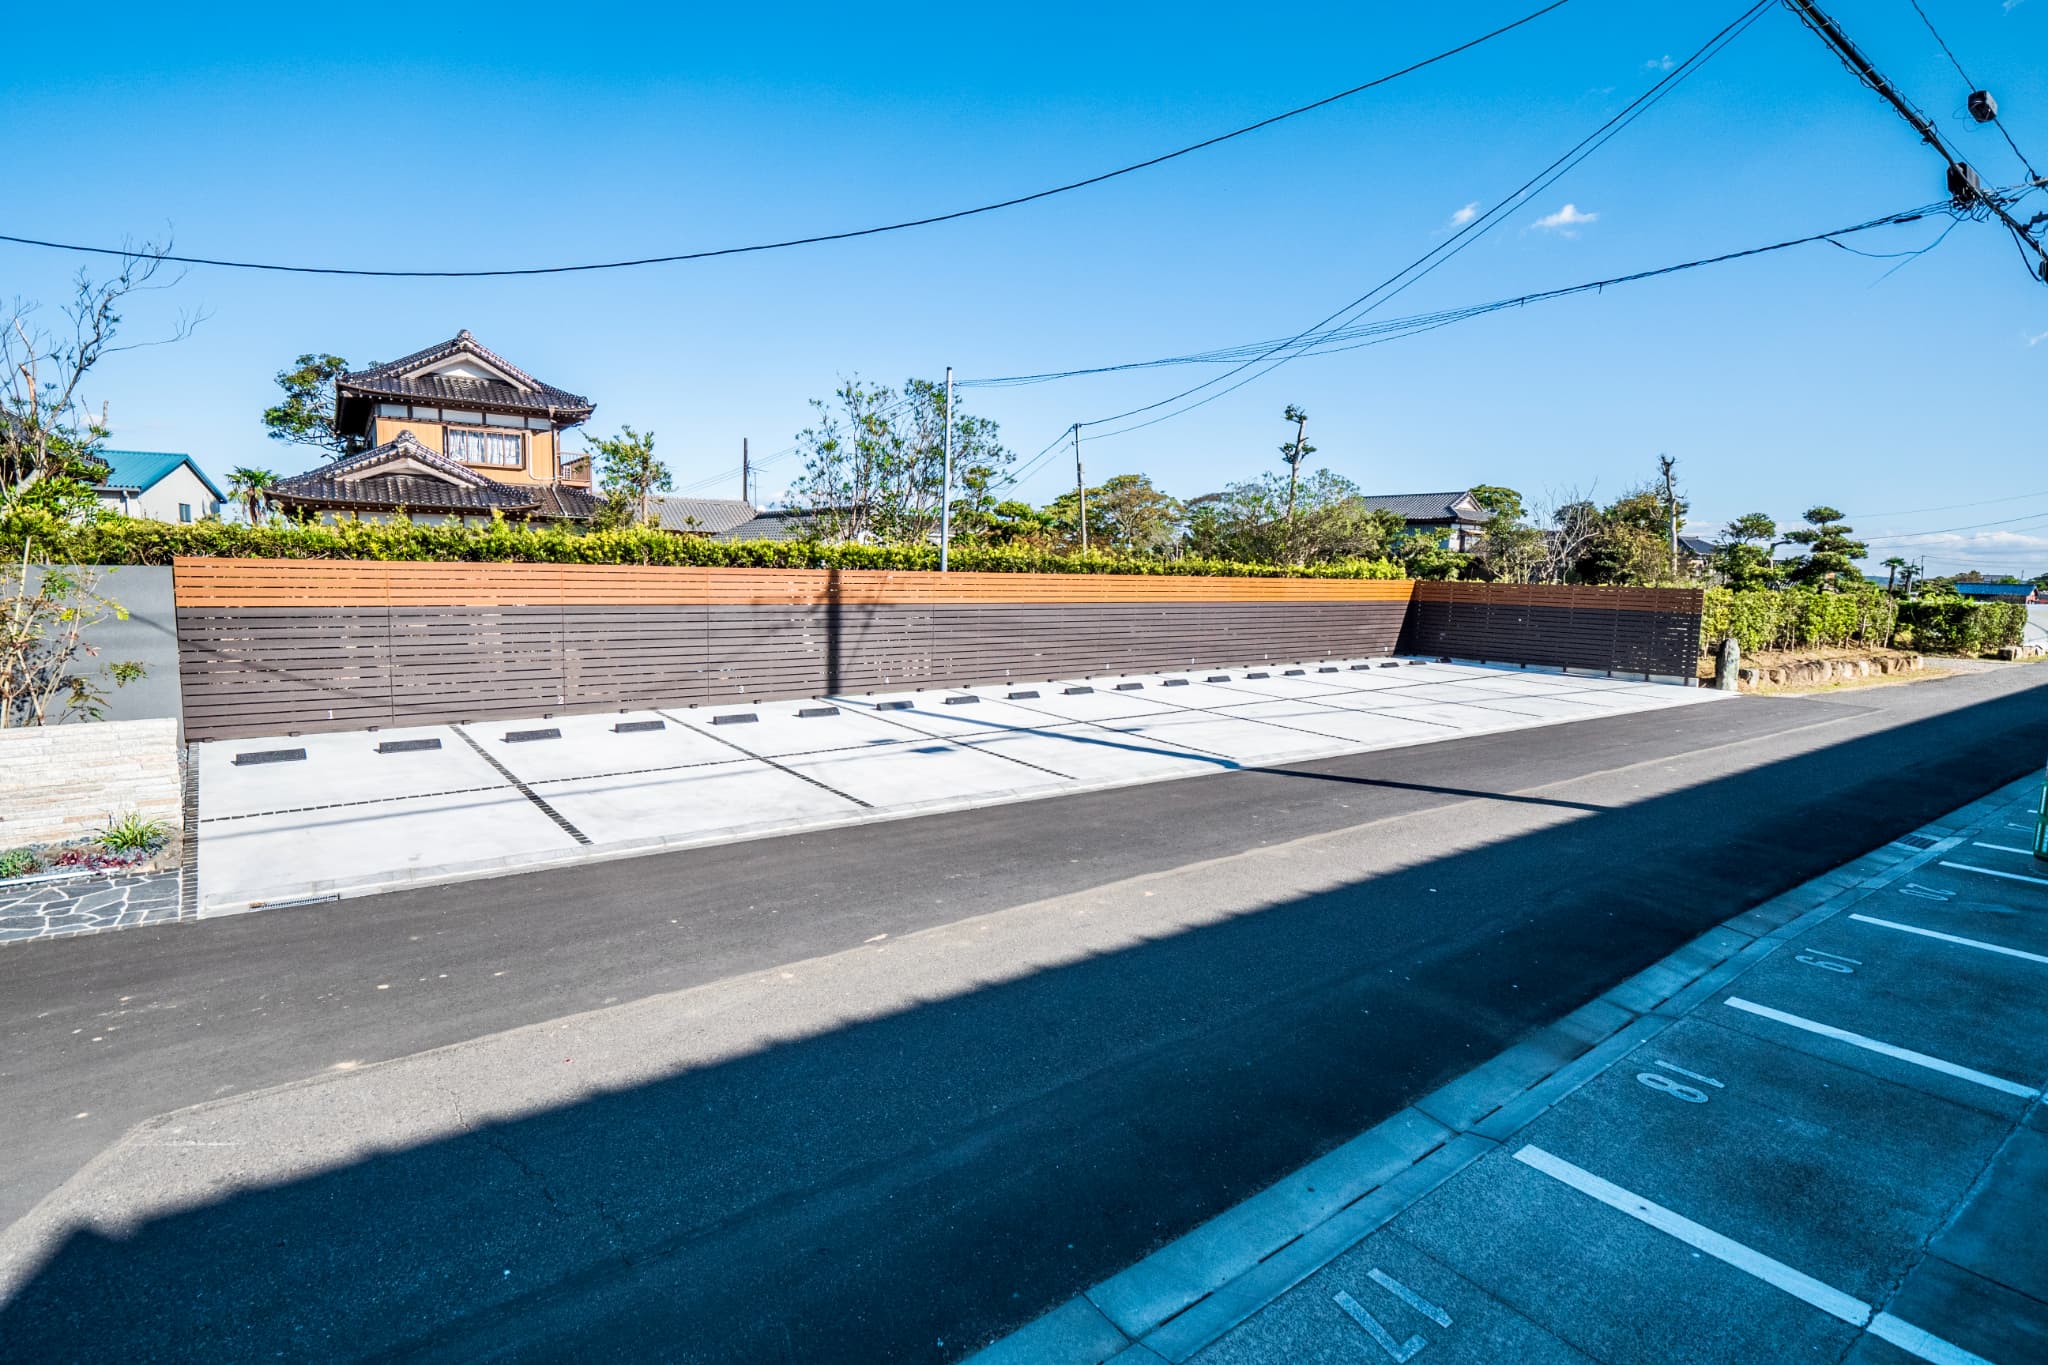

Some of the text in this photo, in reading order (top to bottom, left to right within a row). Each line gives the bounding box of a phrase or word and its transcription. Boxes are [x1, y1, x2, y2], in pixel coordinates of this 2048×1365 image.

[737, 685, 745, 693] 3
[557, 695, 564, 705] 2
[327, 709, 334, 719] 1
[1794, 947, 1863, 974] 19
[1636, 1060, 1725, 1103] 18
[1332, 1267, 1454, 1364] 17
